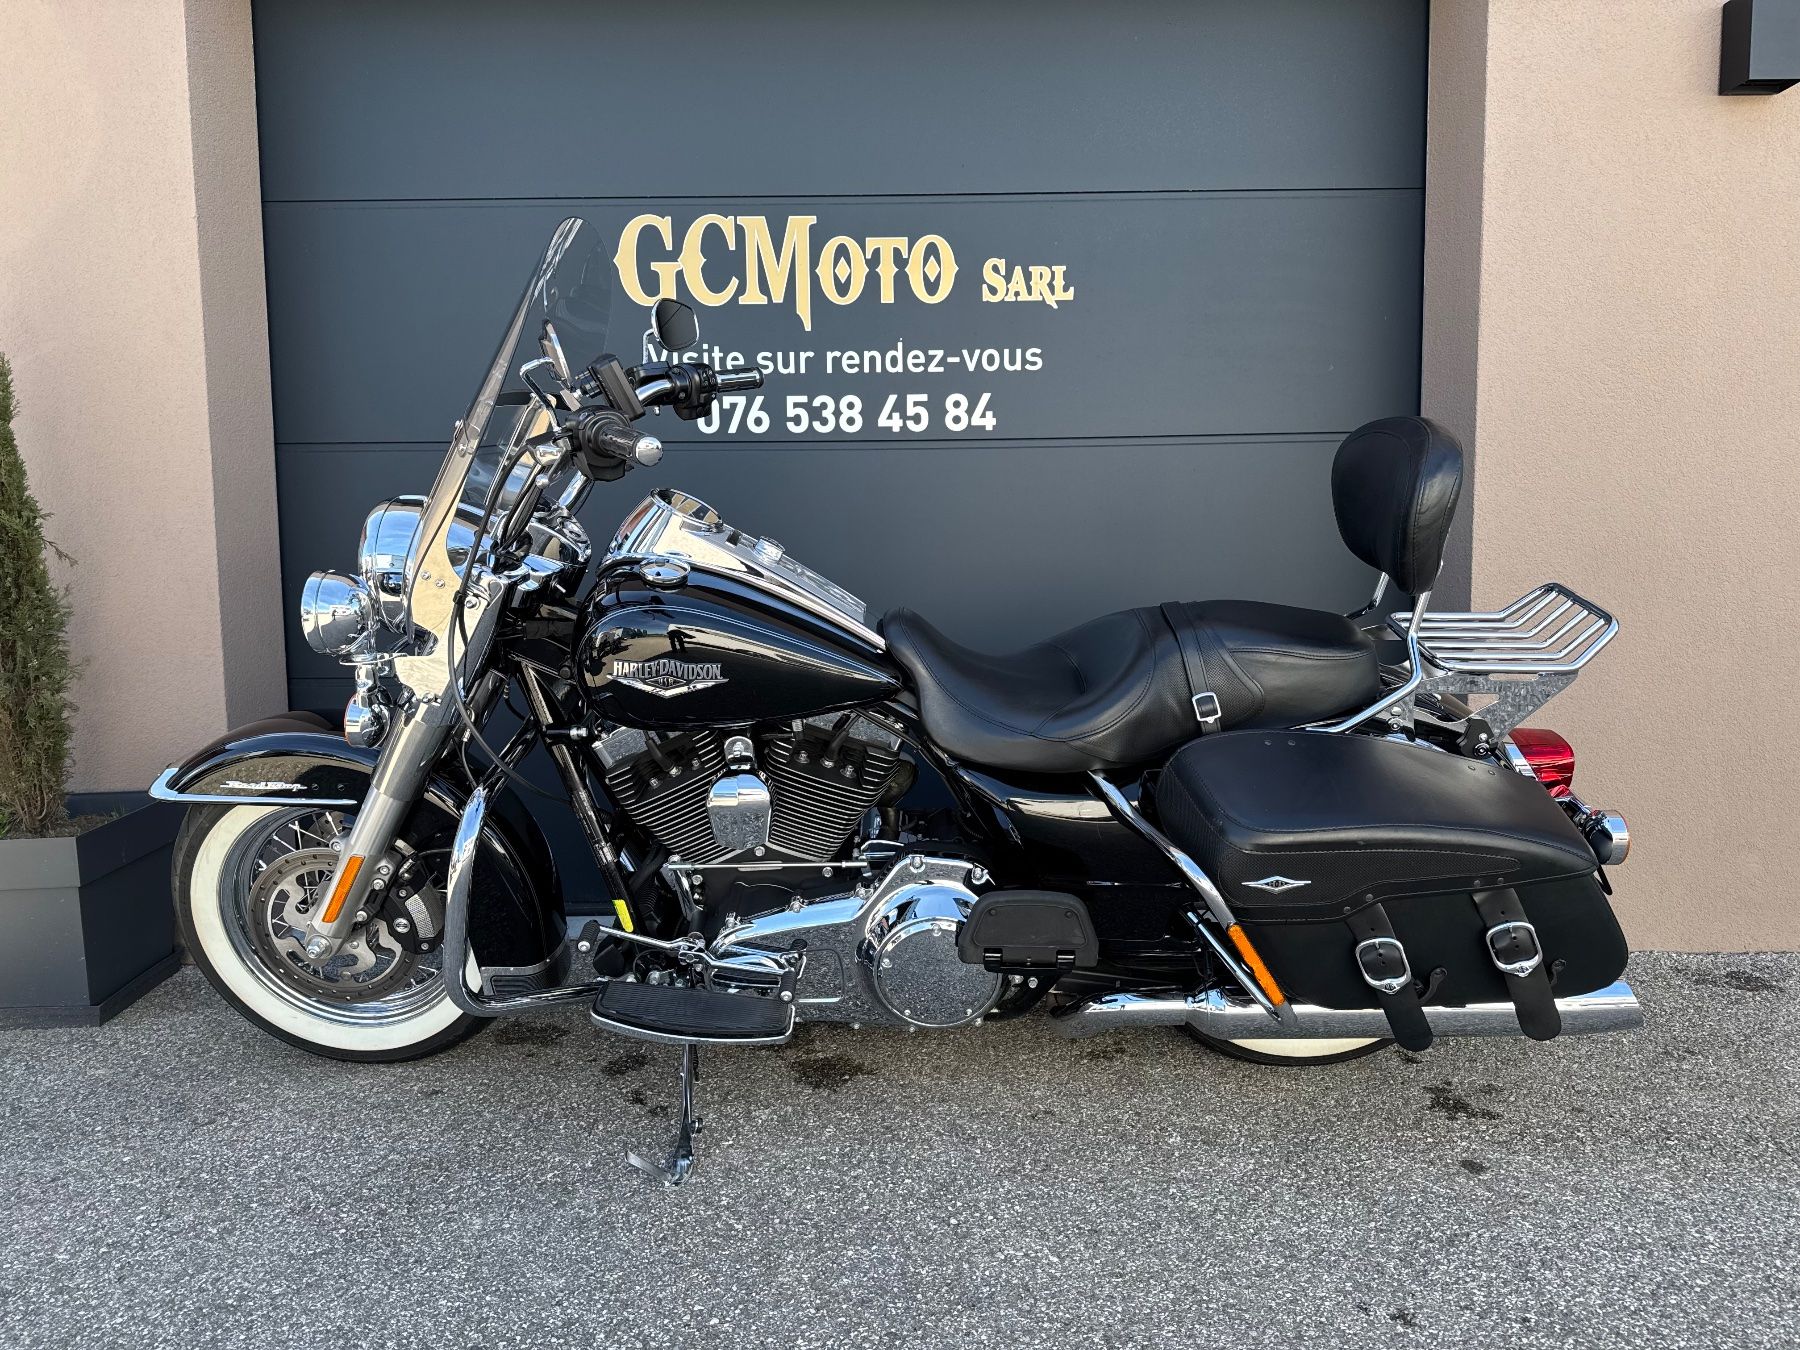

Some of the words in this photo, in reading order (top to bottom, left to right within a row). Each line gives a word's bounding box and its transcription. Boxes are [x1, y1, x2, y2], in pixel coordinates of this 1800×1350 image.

[981, 257, 1075, 309] SARL
[756, 351, 814, 375] sur
[826, 341, 1043, 375] rendez-vous
[696, 395, 770, 434] 076
[786, 394, 863, 434] 538
[877, 393, 929, 433] 45
[944, 392, 997, 433] 84
